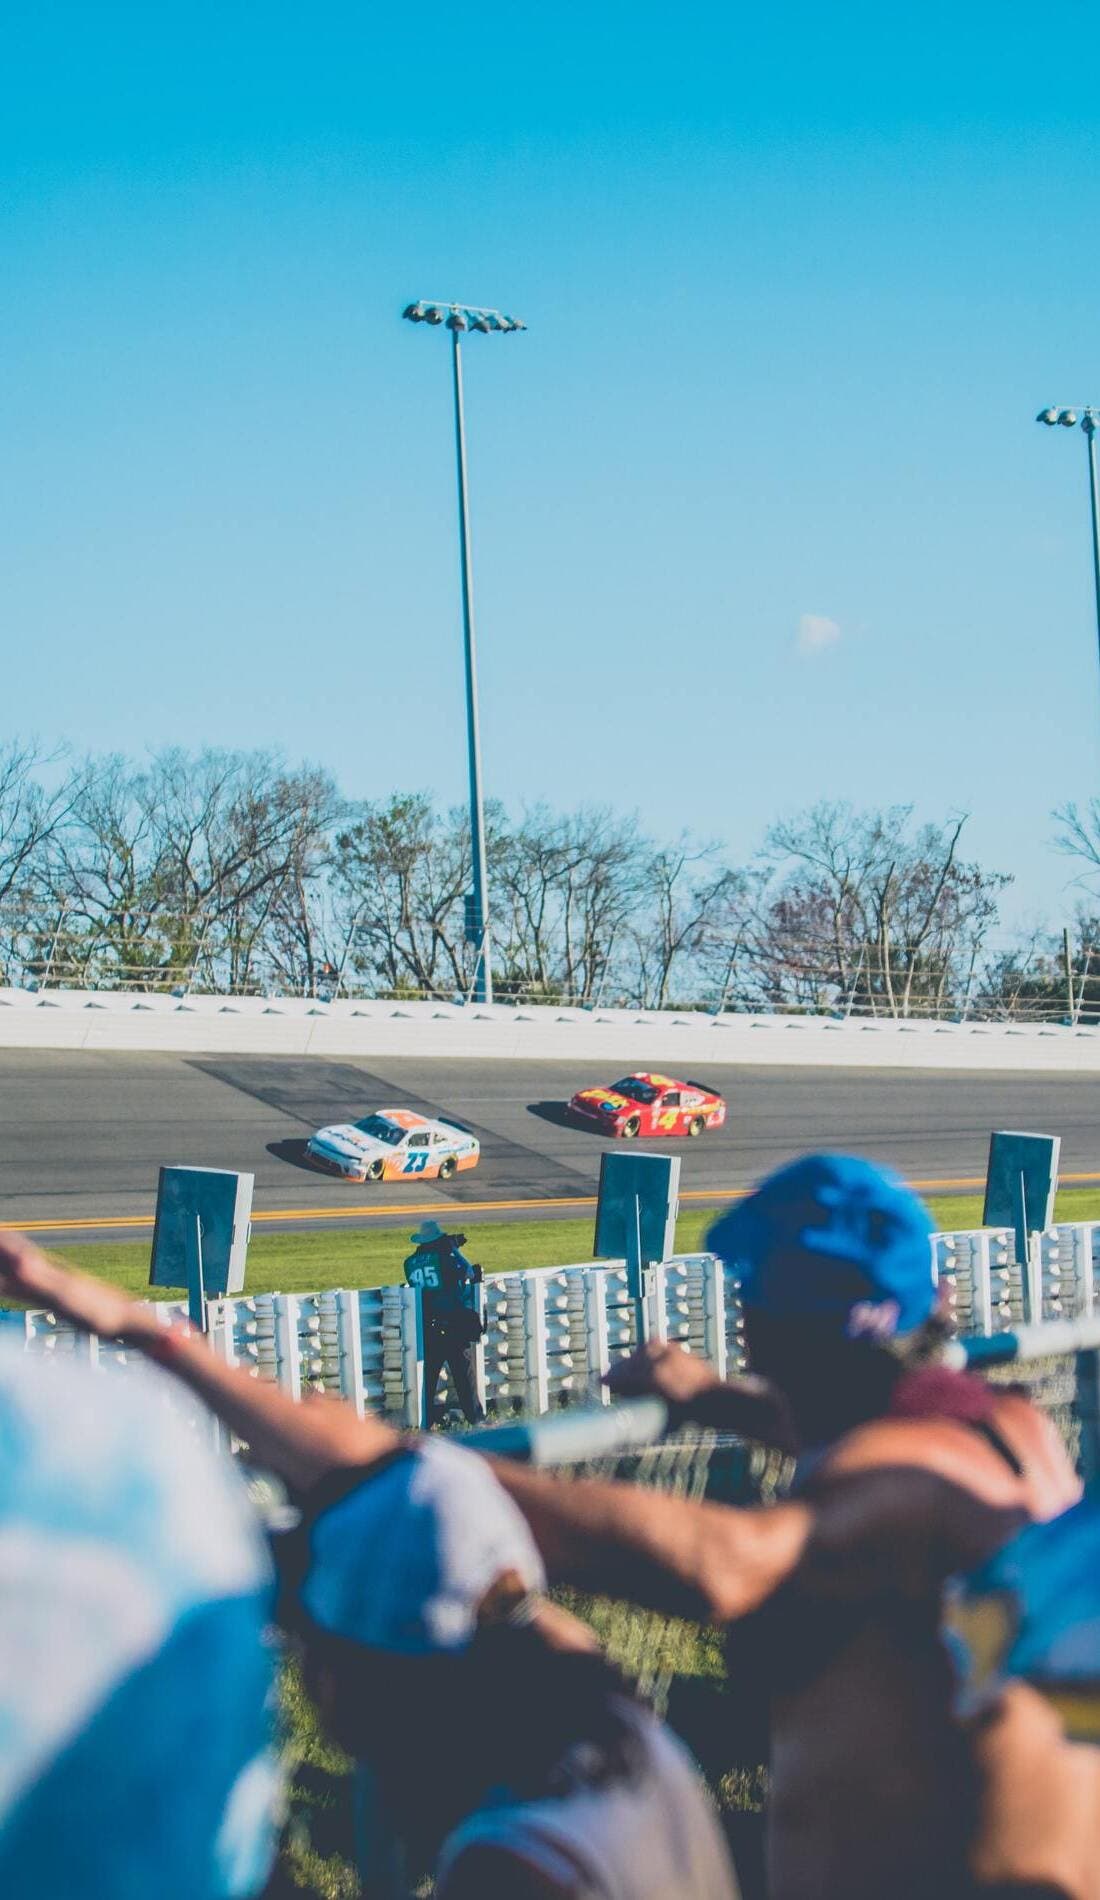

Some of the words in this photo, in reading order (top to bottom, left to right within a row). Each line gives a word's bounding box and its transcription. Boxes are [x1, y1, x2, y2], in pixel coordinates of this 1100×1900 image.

[659, 1109, 679, 1130] 4
[403, 1152, 429, 1173] 23
[409, 1266, 439, 1288] 95
